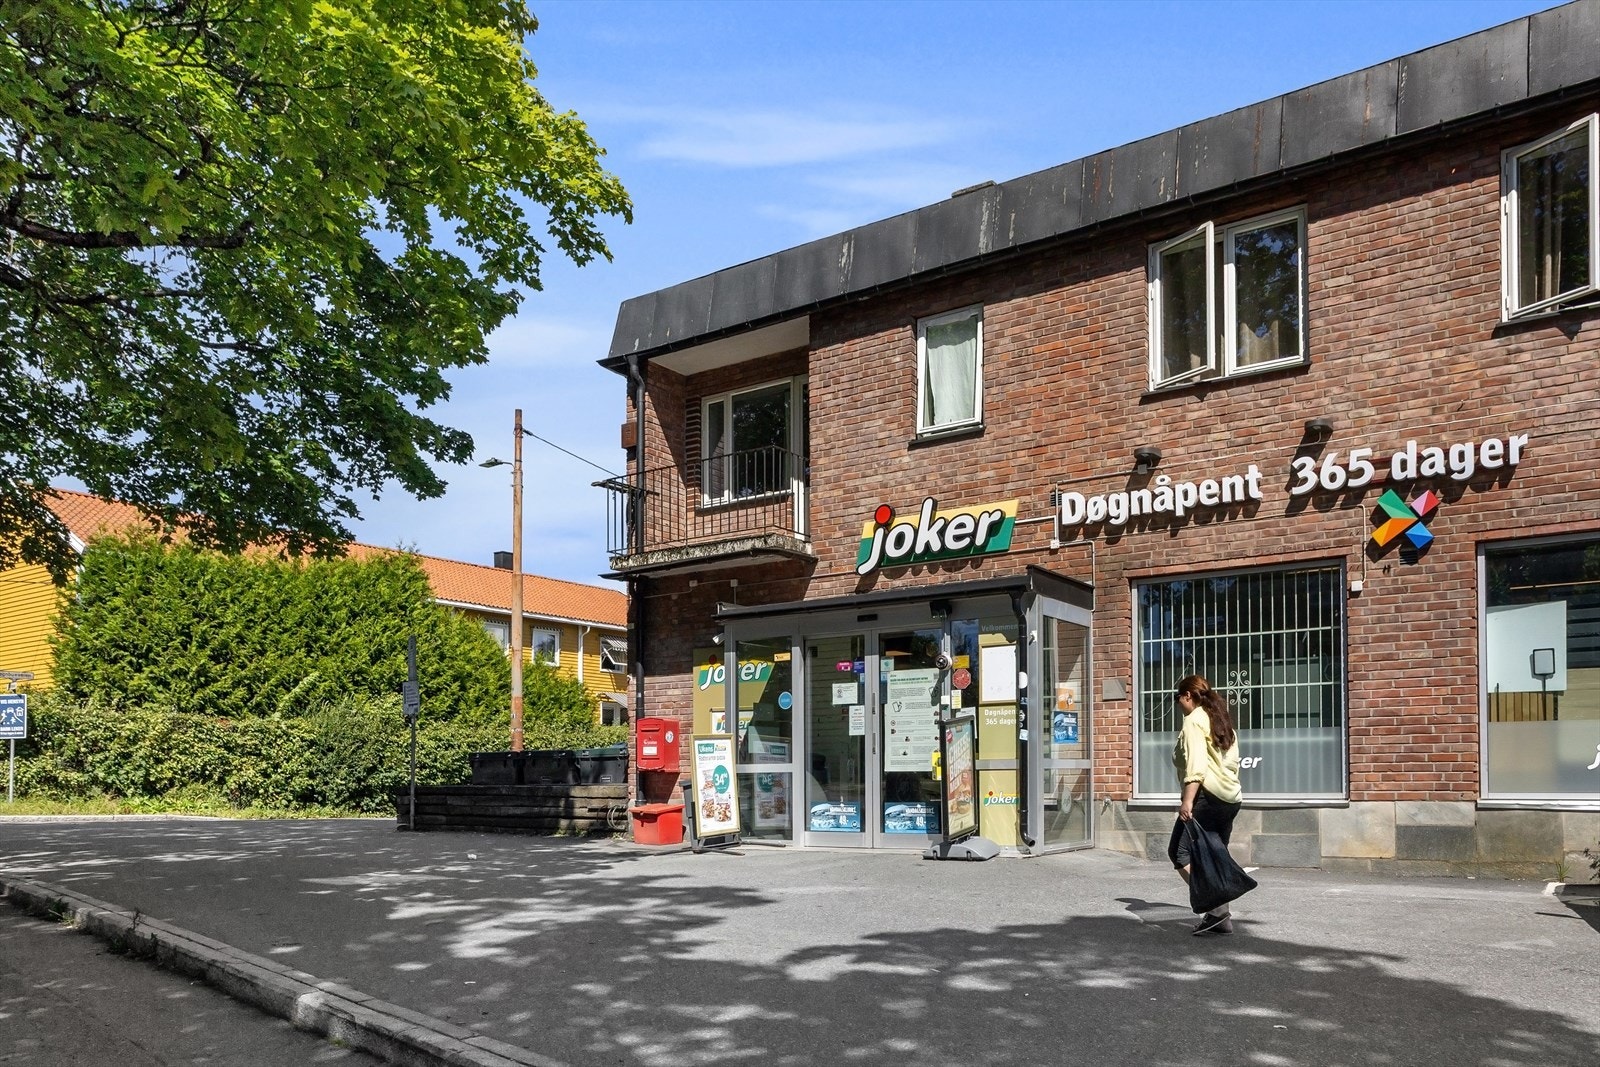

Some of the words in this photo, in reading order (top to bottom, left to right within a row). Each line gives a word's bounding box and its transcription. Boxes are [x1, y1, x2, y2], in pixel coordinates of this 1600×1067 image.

[1061, 463, 1264, 527] Døgnåpent
[1290, 446, 1376, 497] 365
[1390, 433, 1530, 482] dager
[856, 496, 1005, 576] joker
[699, 654, 769, 691] joer
[984, 708, 1017, 717] Døgnåpen
[985, 717, 998, 726] 365
[985, 790, 1018, 806] joker
